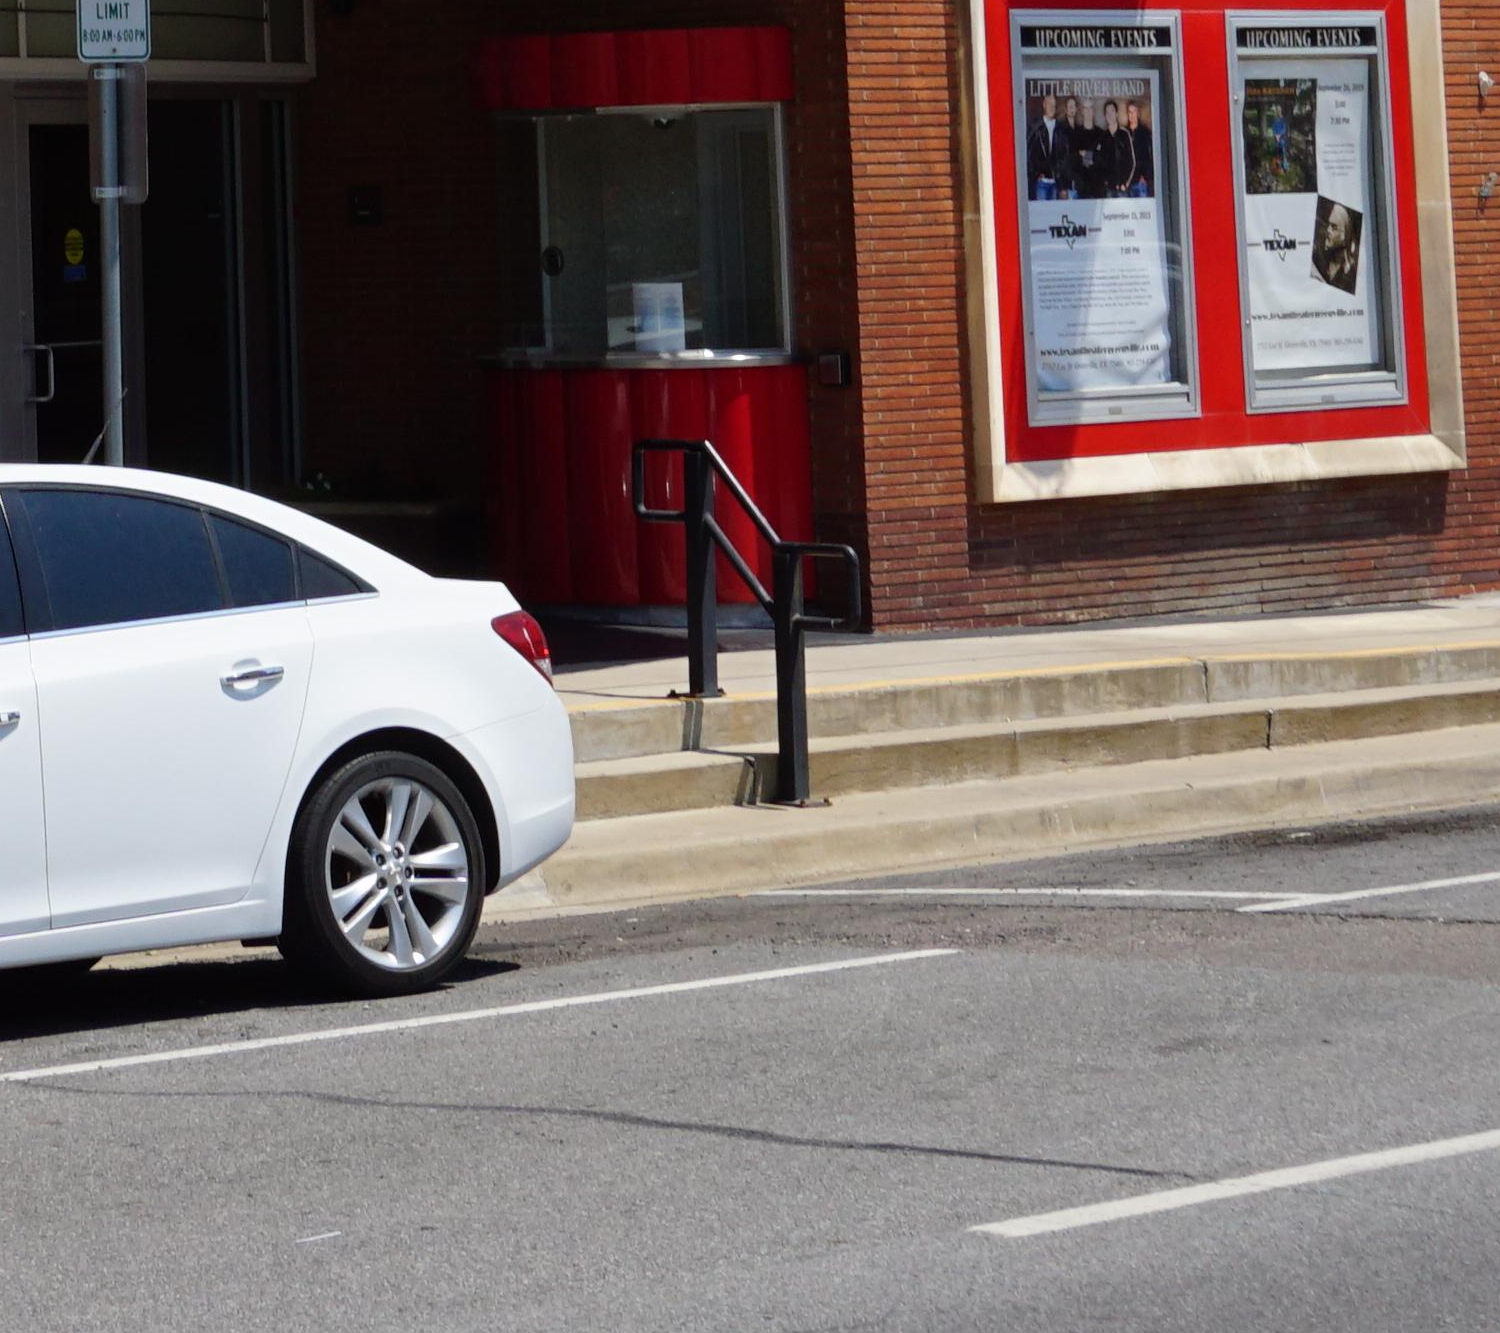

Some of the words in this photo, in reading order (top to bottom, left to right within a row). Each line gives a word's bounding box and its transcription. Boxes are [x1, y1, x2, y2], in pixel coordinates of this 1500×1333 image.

[96, 3, 130, 20] LIMIT
[1035, 29, 1105, 48] UPCOMING
[1111, 29, 1157, 48] EVENTS
[1246, 28, 1311, 48] UPCOMING
[1317, 27, 1361, 47] EVENTS
[1030, 80, 1072, 97] LITTLE
[1073, 79, 1110, 97] RIVER
[1113, 80, 1145, 96] BAND
[1049, 224, 1087, 239] TEXAN
[1262, 238, 1297, 252] TEXAN
